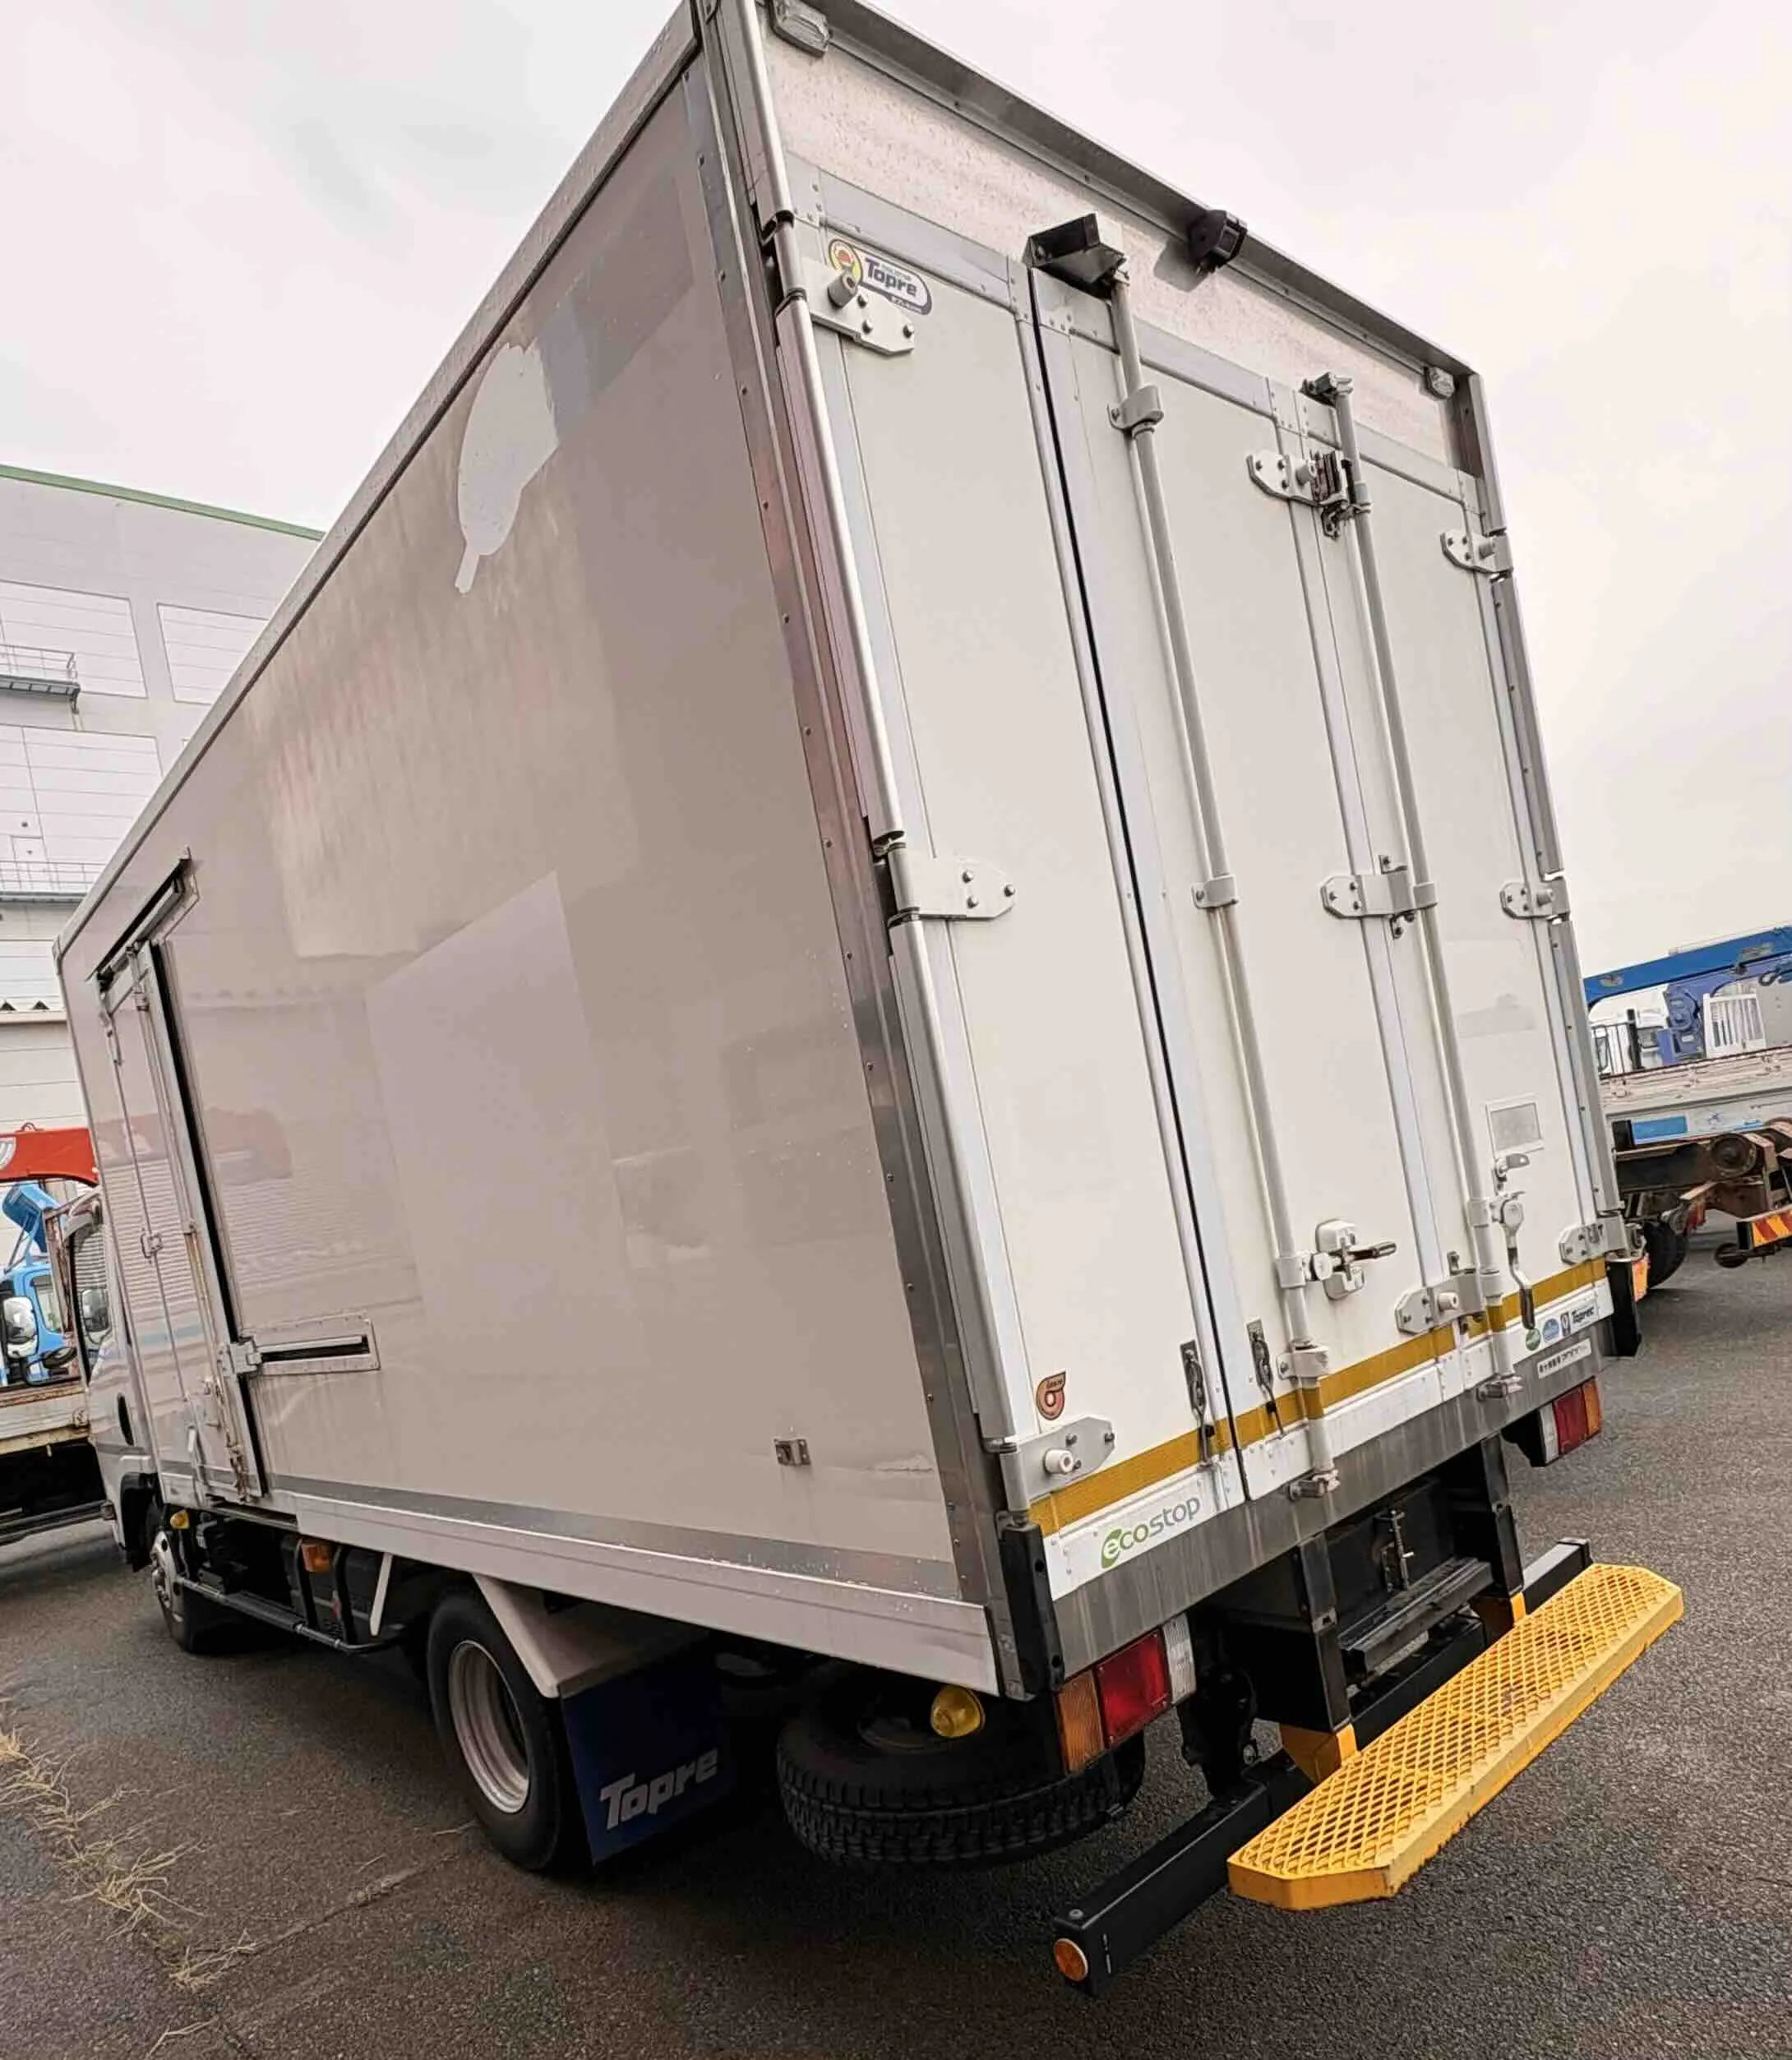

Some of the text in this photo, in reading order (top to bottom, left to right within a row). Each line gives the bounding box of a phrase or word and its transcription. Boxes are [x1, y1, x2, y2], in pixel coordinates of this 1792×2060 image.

[865, 256, 917, 297] Topre
[1102, 1497, 1201, 1568] ecostop
[599, 1747, 718, 1831] Topre
